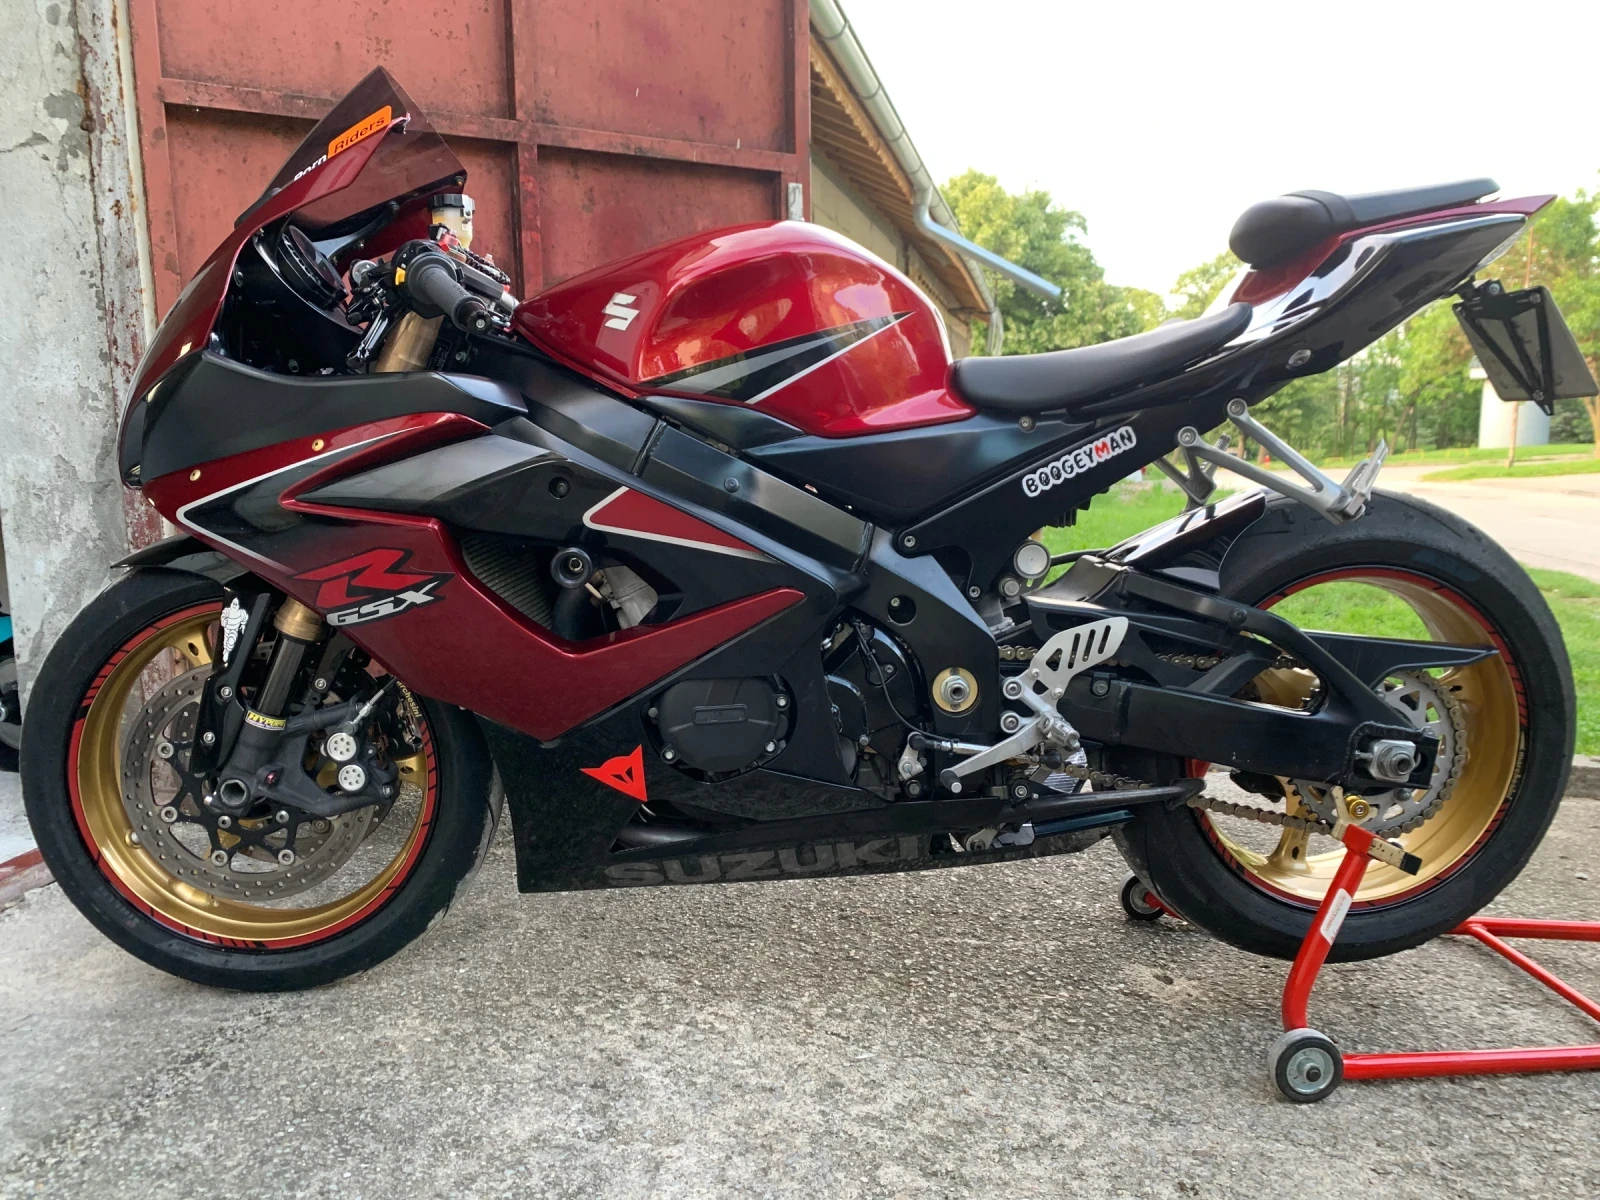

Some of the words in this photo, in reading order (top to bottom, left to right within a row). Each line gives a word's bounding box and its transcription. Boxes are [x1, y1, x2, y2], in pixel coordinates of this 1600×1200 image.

[334, 116, 386, 154] Riders
[1025, 429, 1134, 494] BOOGEYMAN
[326, 580, 440, 626] GSX
[396, 680, 422, 718] archesini
[604, 835, 920, 887] SUZUKI
